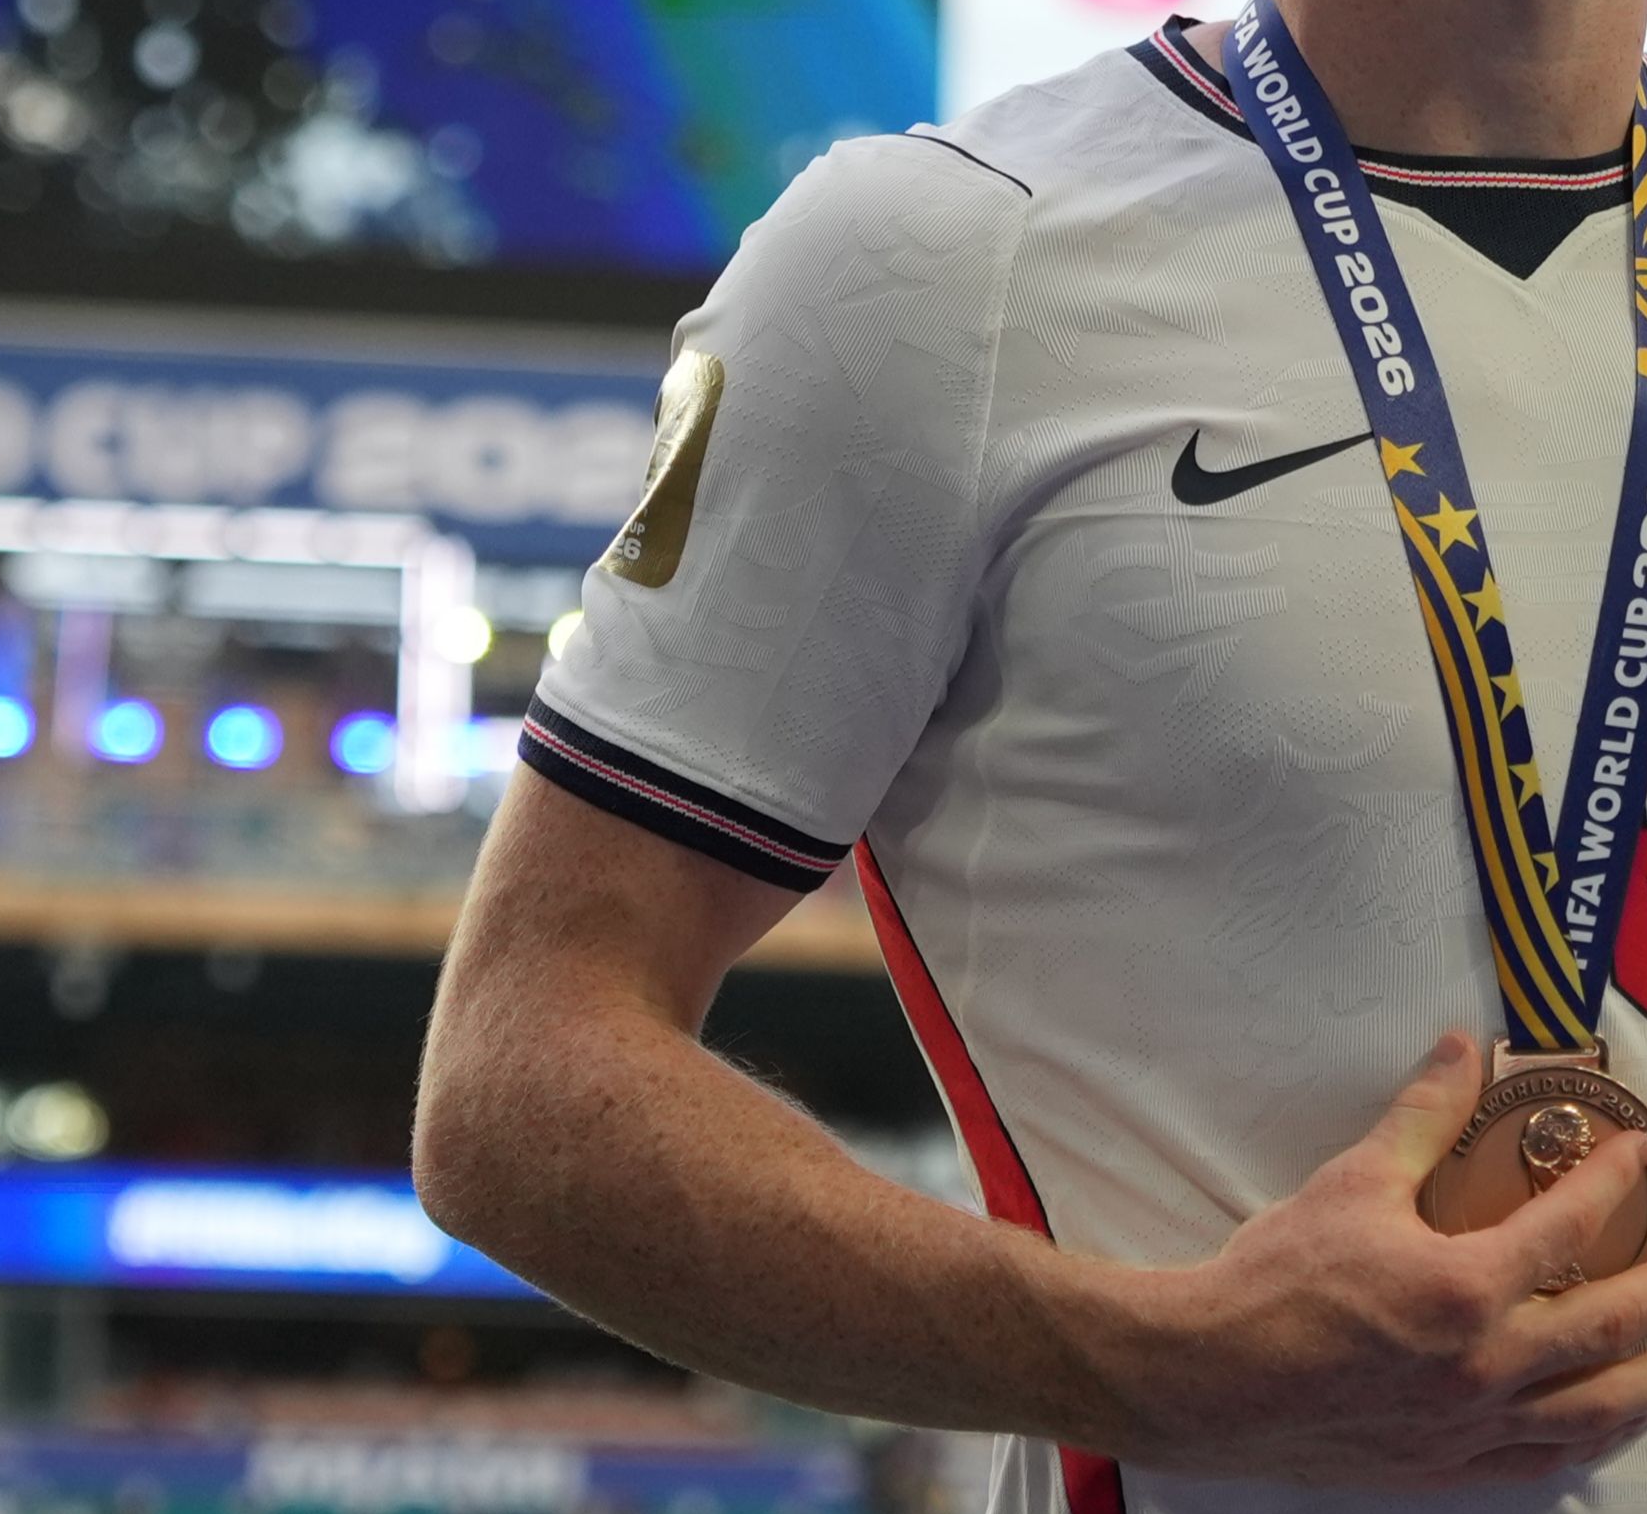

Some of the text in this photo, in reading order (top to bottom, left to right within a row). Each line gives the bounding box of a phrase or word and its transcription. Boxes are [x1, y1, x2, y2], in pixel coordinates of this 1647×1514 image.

[1242, 37, 1324, 164] WORLD
[1304, 167, 1359, 246] CUP
[1335, 251, 1415, 397] 2026
[43, 381, 310, 508] CUP
[317, 389, 650, 528] 202
[1577, 695, 1640, 863] WORLD
[1484, 1077, 1554, 1116] WORLD
[1560, 1076, 1602, 1098] CUP
